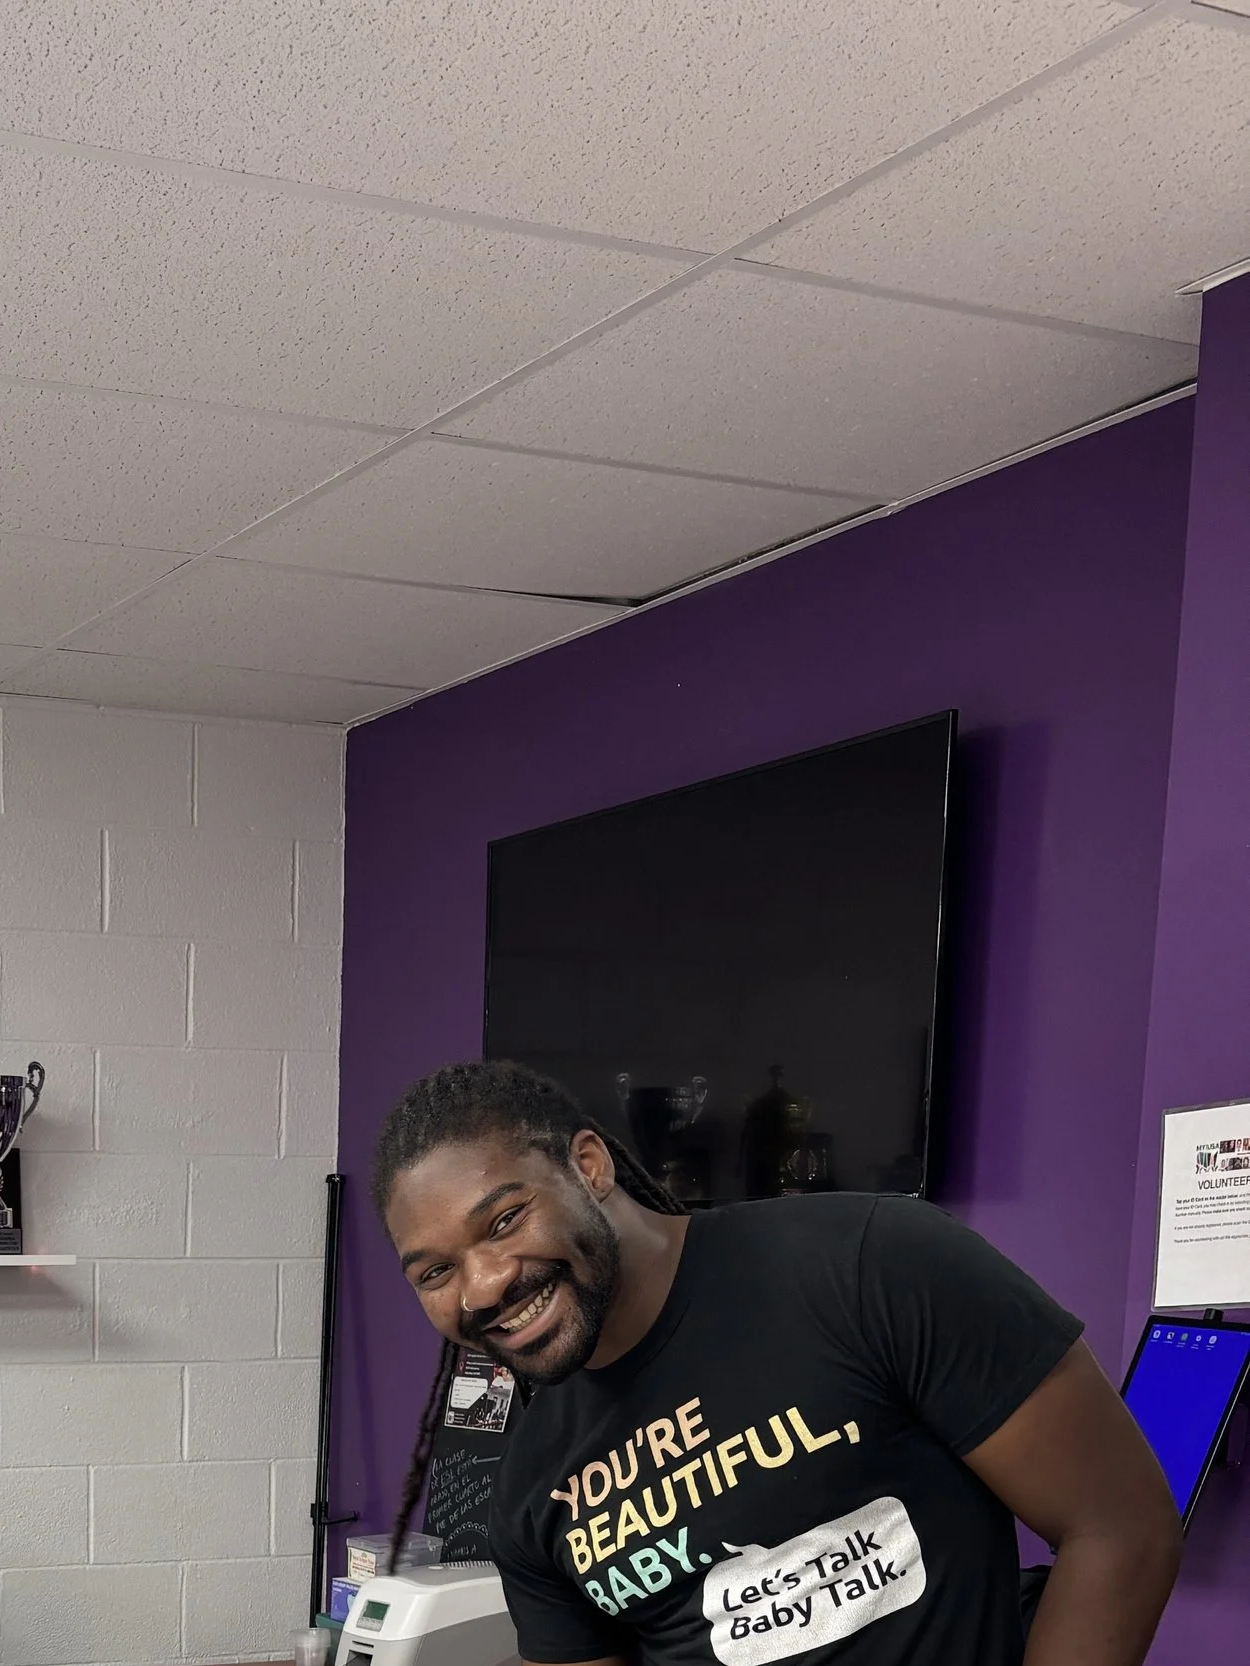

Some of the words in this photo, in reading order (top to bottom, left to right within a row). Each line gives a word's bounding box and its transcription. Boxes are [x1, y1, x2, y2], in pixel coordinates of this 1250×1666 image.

[550, 1397, 710, 1521] YOU'RE
[565, 1407, 861, 1574] BEAUTIFUL,
[585, 1526, 713, 1616] BABY.
[722, 1568, 800, 1612] Let's
[805, 1529, 883, 1579] Talk
[730, 1596, 812, 1640] Baby
[819, 1557, 907, 1607] Talk.
